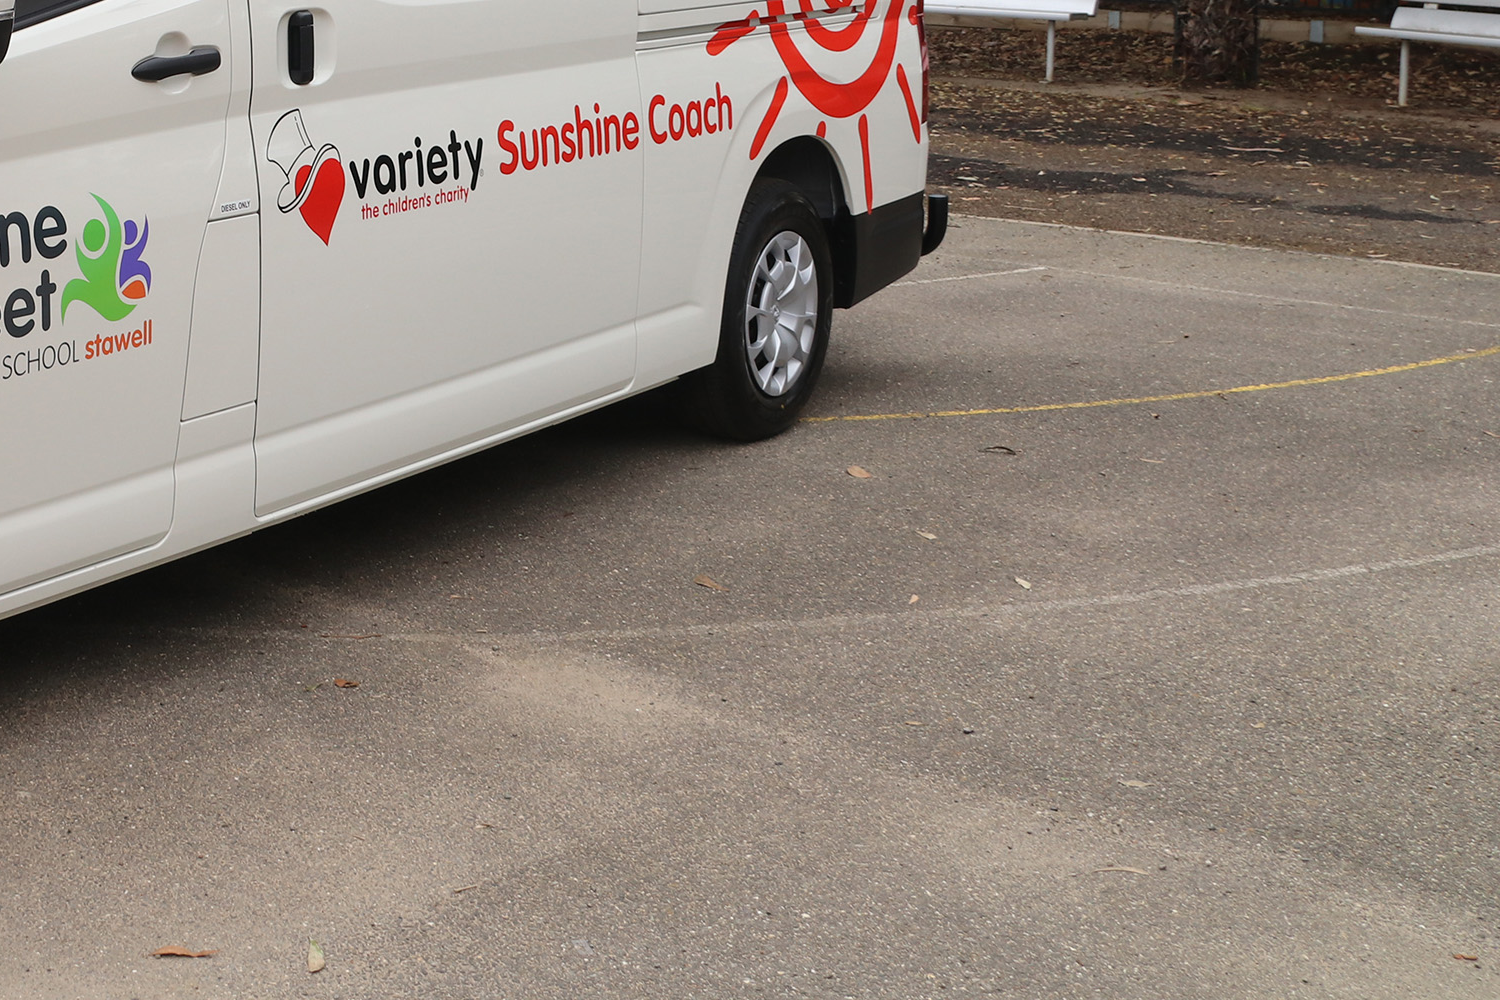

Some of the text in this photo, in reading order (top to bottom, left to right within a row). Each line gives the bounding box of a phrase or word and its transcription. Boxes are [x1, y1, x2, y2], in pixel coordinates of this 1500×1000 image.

[349, 81, 733, 199] variety Sunshine Coach
[221, 200, 251, 213] DIESEL ONLY
[361, 185, 470, 220] the children's charity
[2, 340, 80, 381] SCHOOL
[85, 319, 152, 360] stawell
